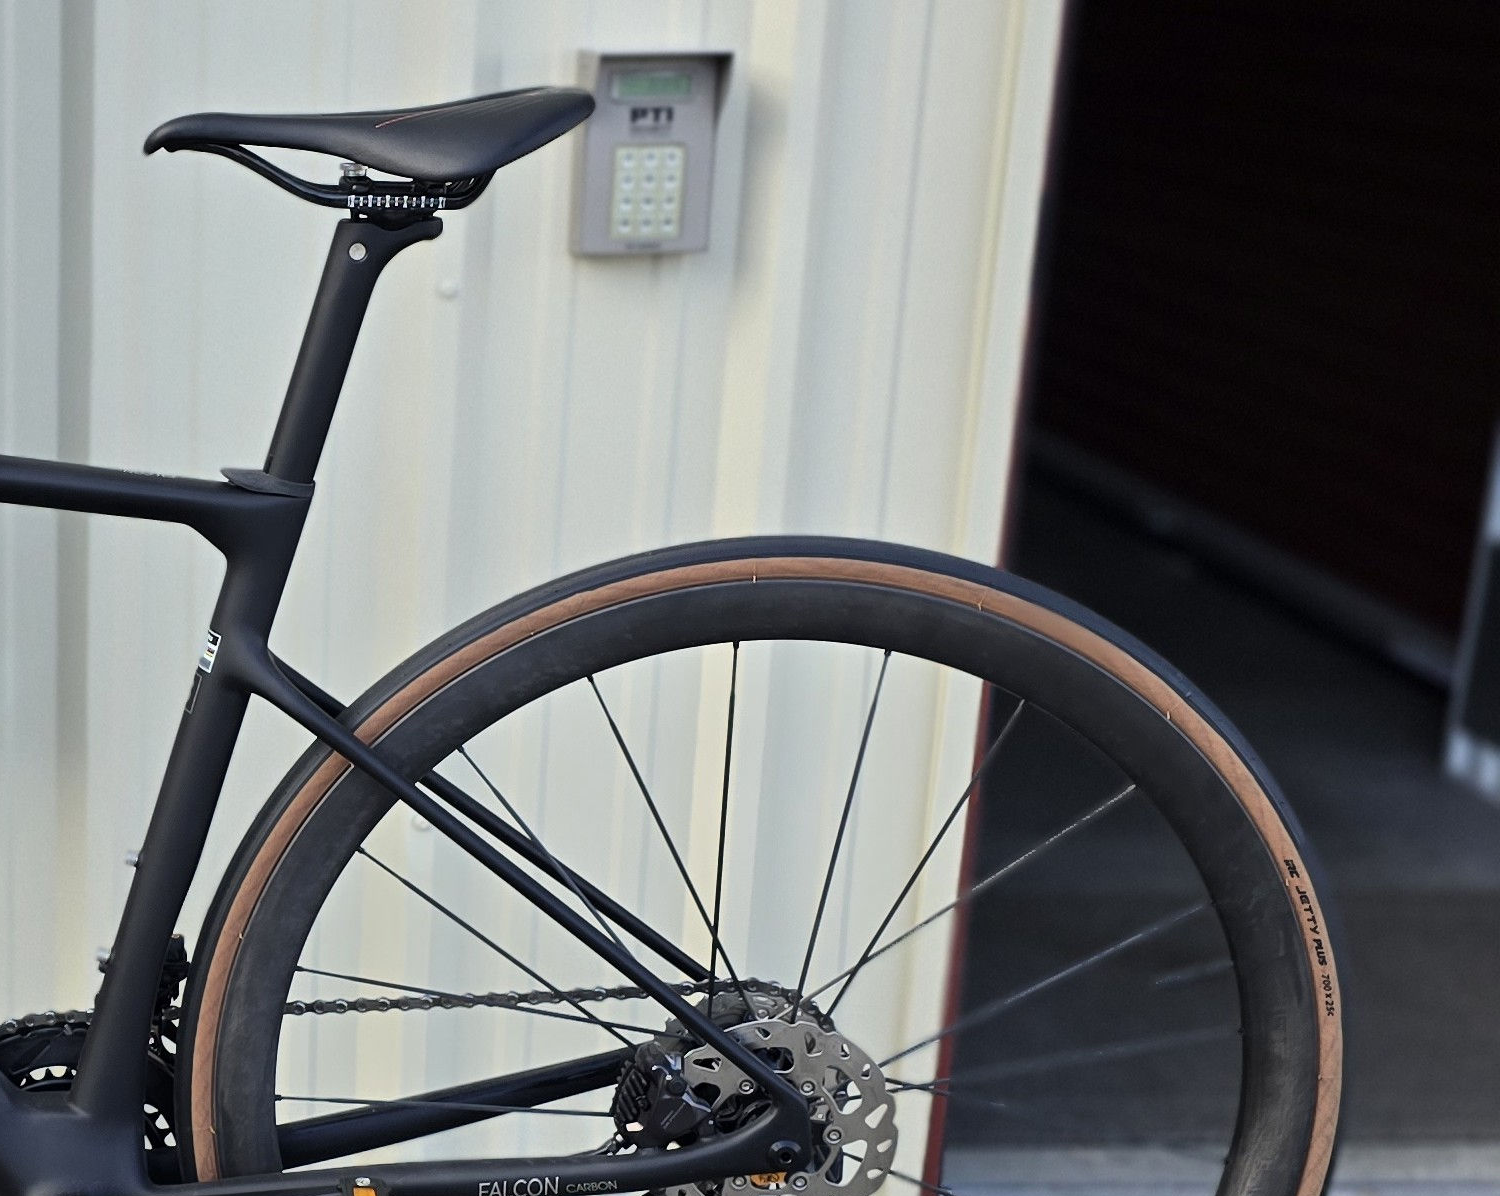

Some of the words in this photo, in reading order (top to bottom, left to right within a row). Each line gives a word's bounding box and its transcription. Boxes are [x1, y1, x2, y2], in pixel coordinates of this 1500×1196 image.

[630, 106, 674, 123] PTI
[1295, 885, 1320, 935] JETTY
[1313, 938, 1327, 966] PLUS
[1321, 974, 1332, 992] 700
[566, 1180, 618, 1193] CARBON
